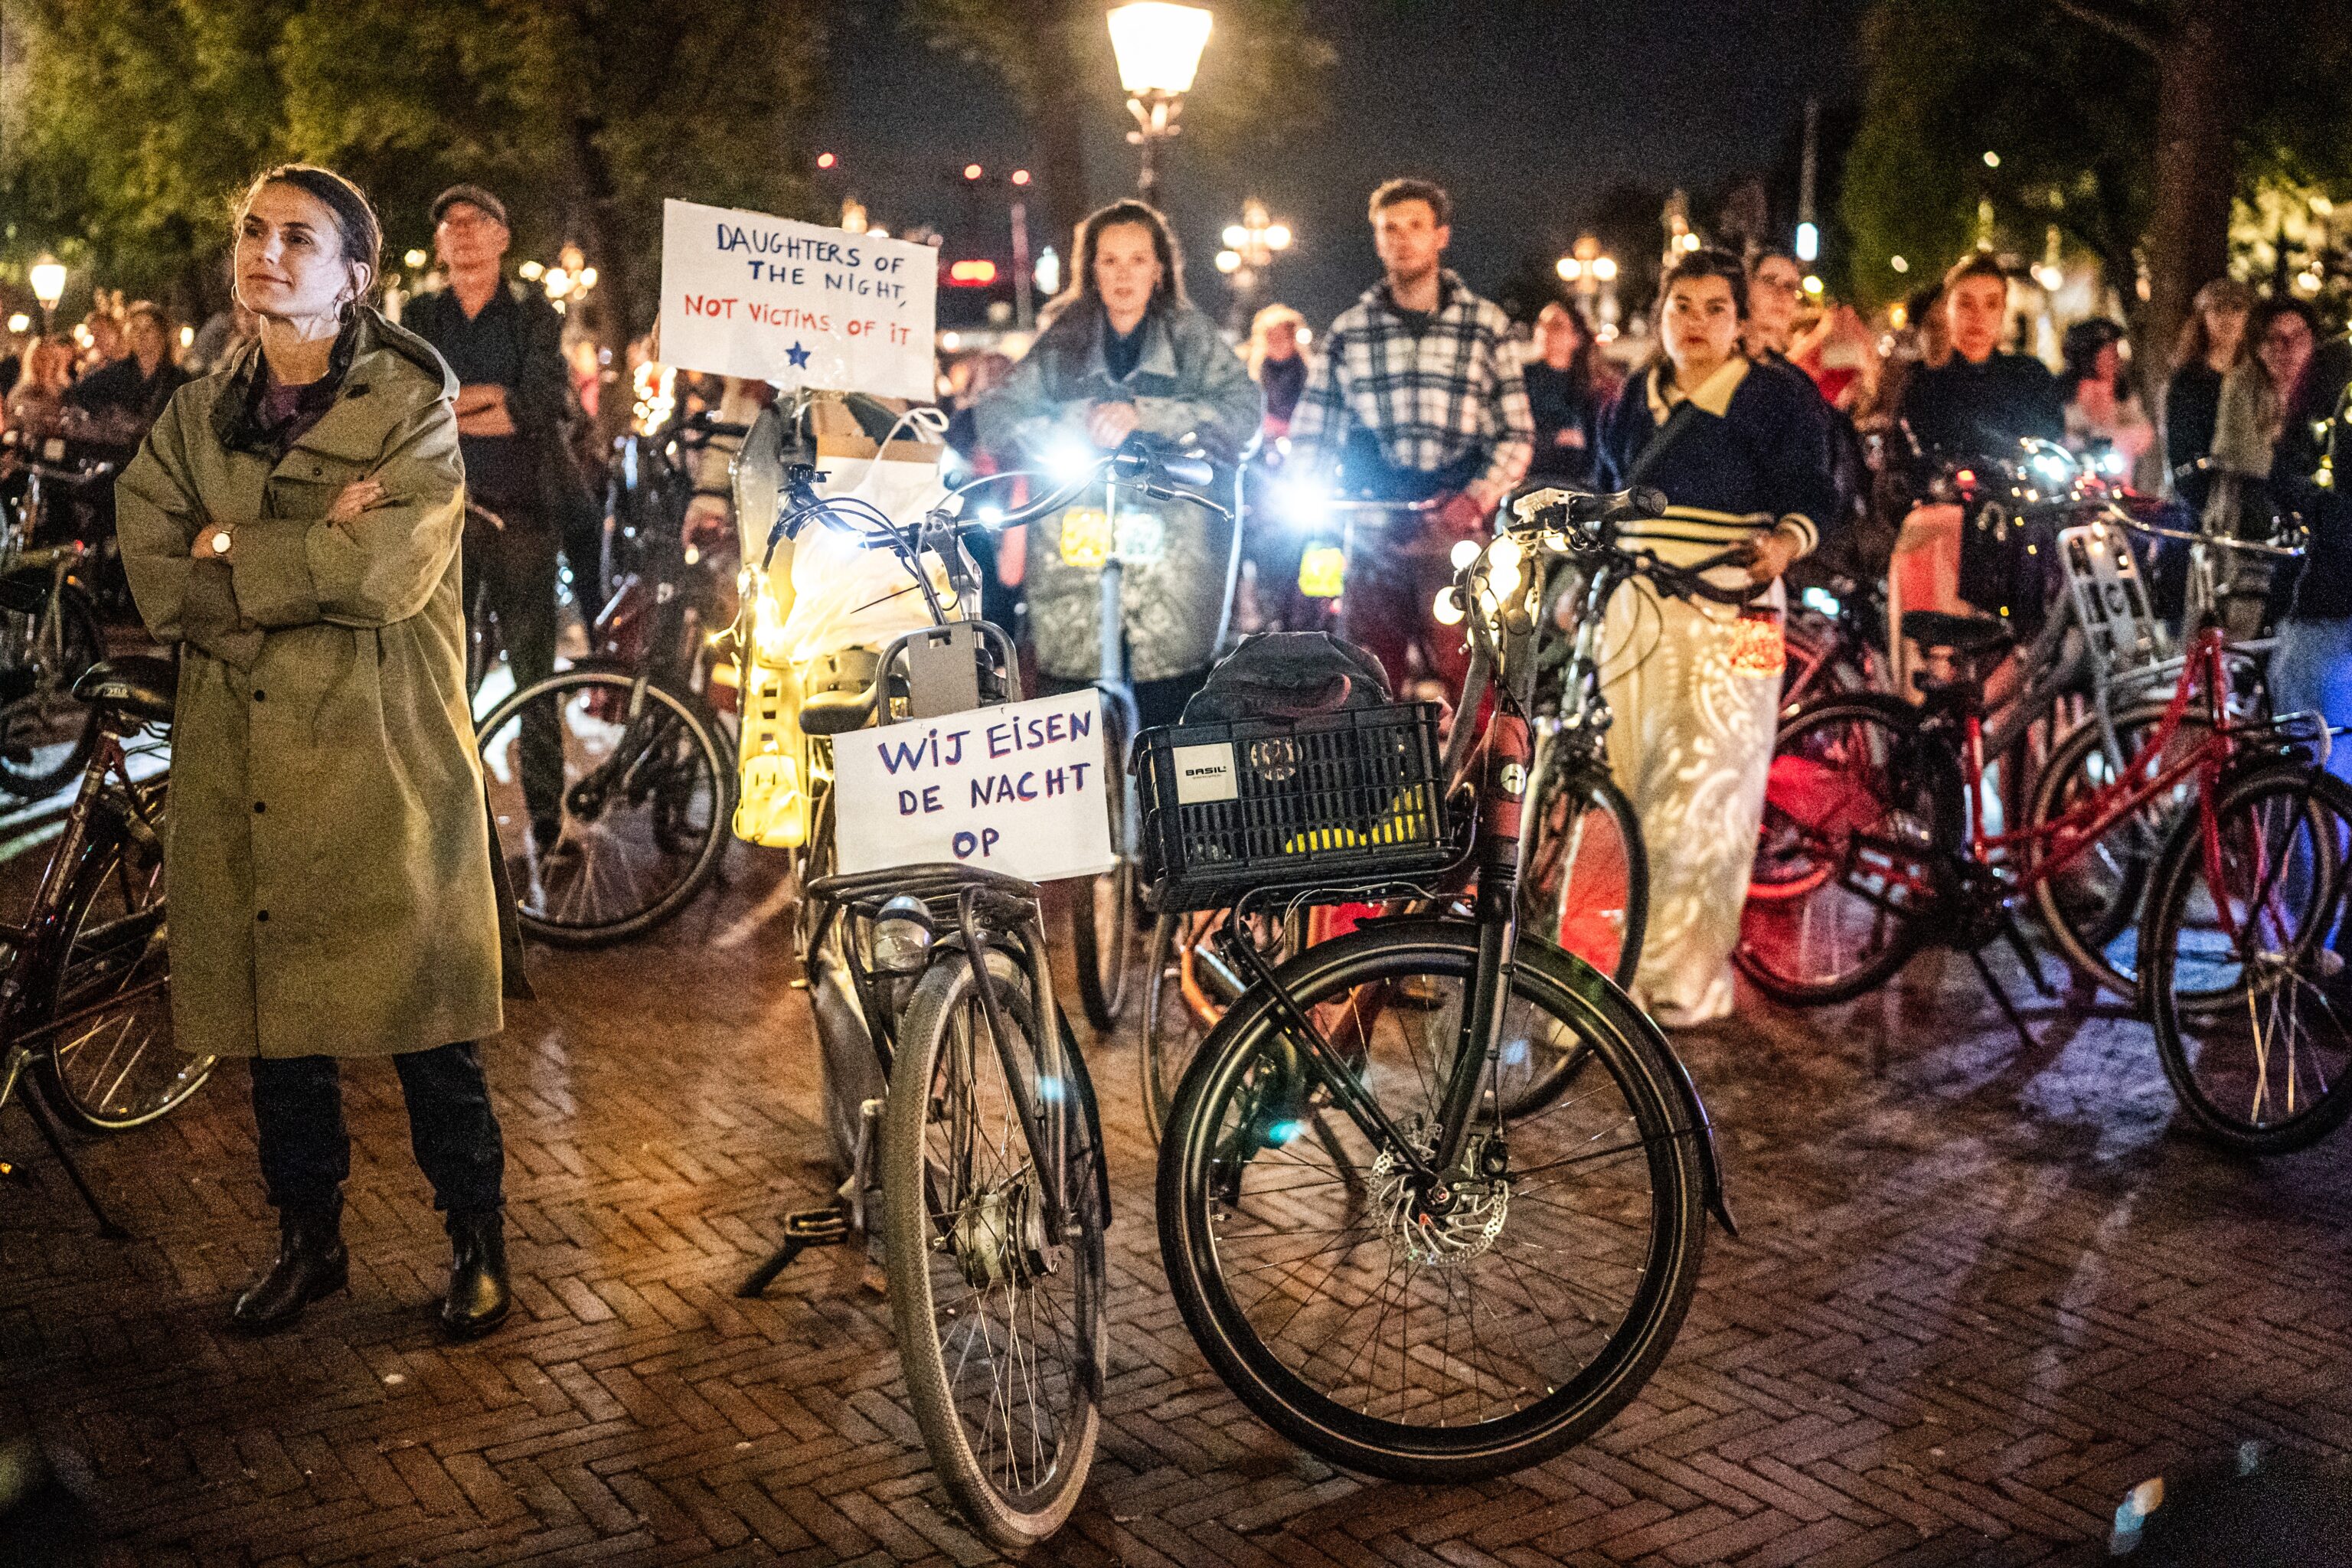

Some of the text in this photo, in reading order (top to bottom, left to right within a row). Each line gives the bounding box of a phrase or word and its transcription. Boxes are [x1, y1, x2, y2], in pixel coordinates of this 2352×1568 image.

[717, 224, 904, 274] DAUGHTERS OF
[748, 260, 906, 308] THE NIGHT,
[685, 294, 737, 319] NOT
[847, 319, 876, 336] OF
[899, 763, 1090, 815] DE NACHT
[1185, 766, 1227, 776] BASIL
[952, 828, 999, 859] OP
